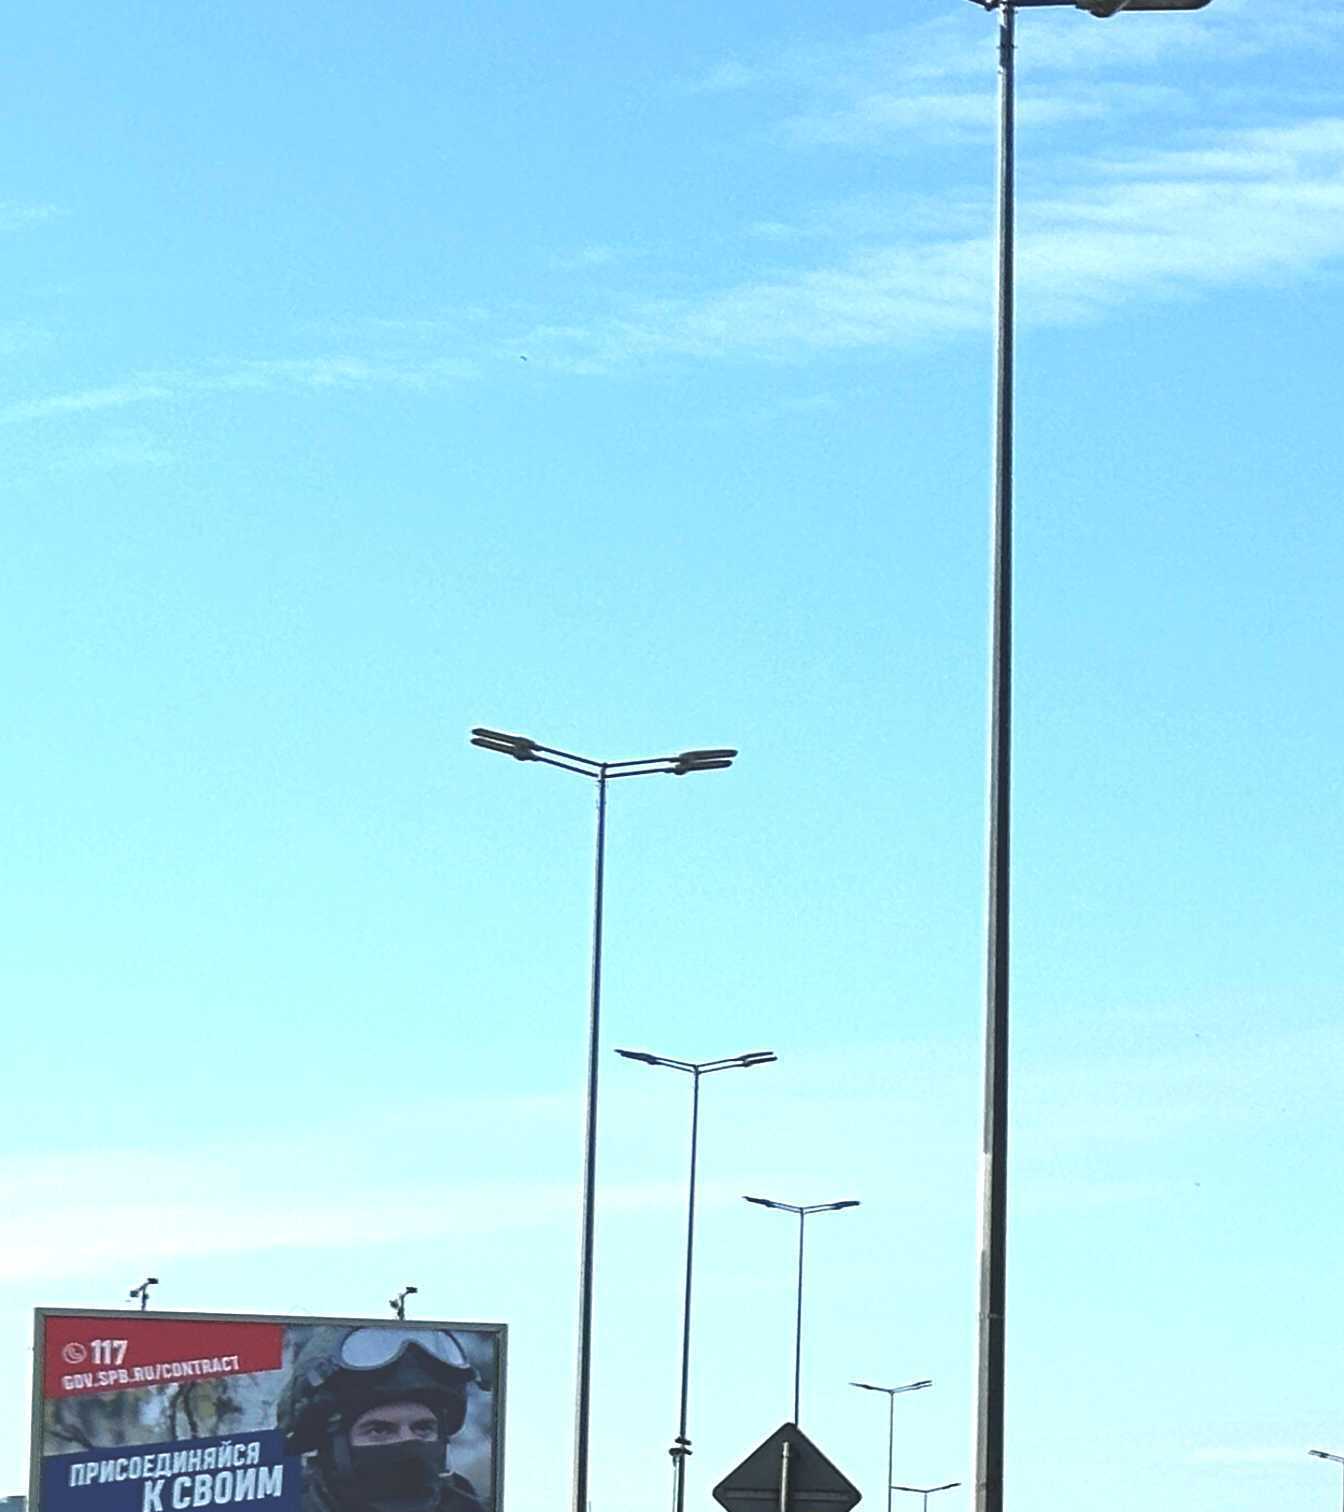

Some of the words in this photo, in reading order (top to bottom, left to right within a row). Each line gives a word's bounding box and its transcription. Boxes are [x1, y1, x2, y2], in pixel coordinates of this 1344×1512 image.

[61, 1355, 240, 1390] GOV.SPB.RU/CONTRACT
[90, 1339, 128, 1365] 117
[69, 1440, 260, 1487] ПРИСОЕДИНЯЙСЯ
[142, 1479, 165, 1512] К
[172, 1465, 284, 1509] СВОИМ
